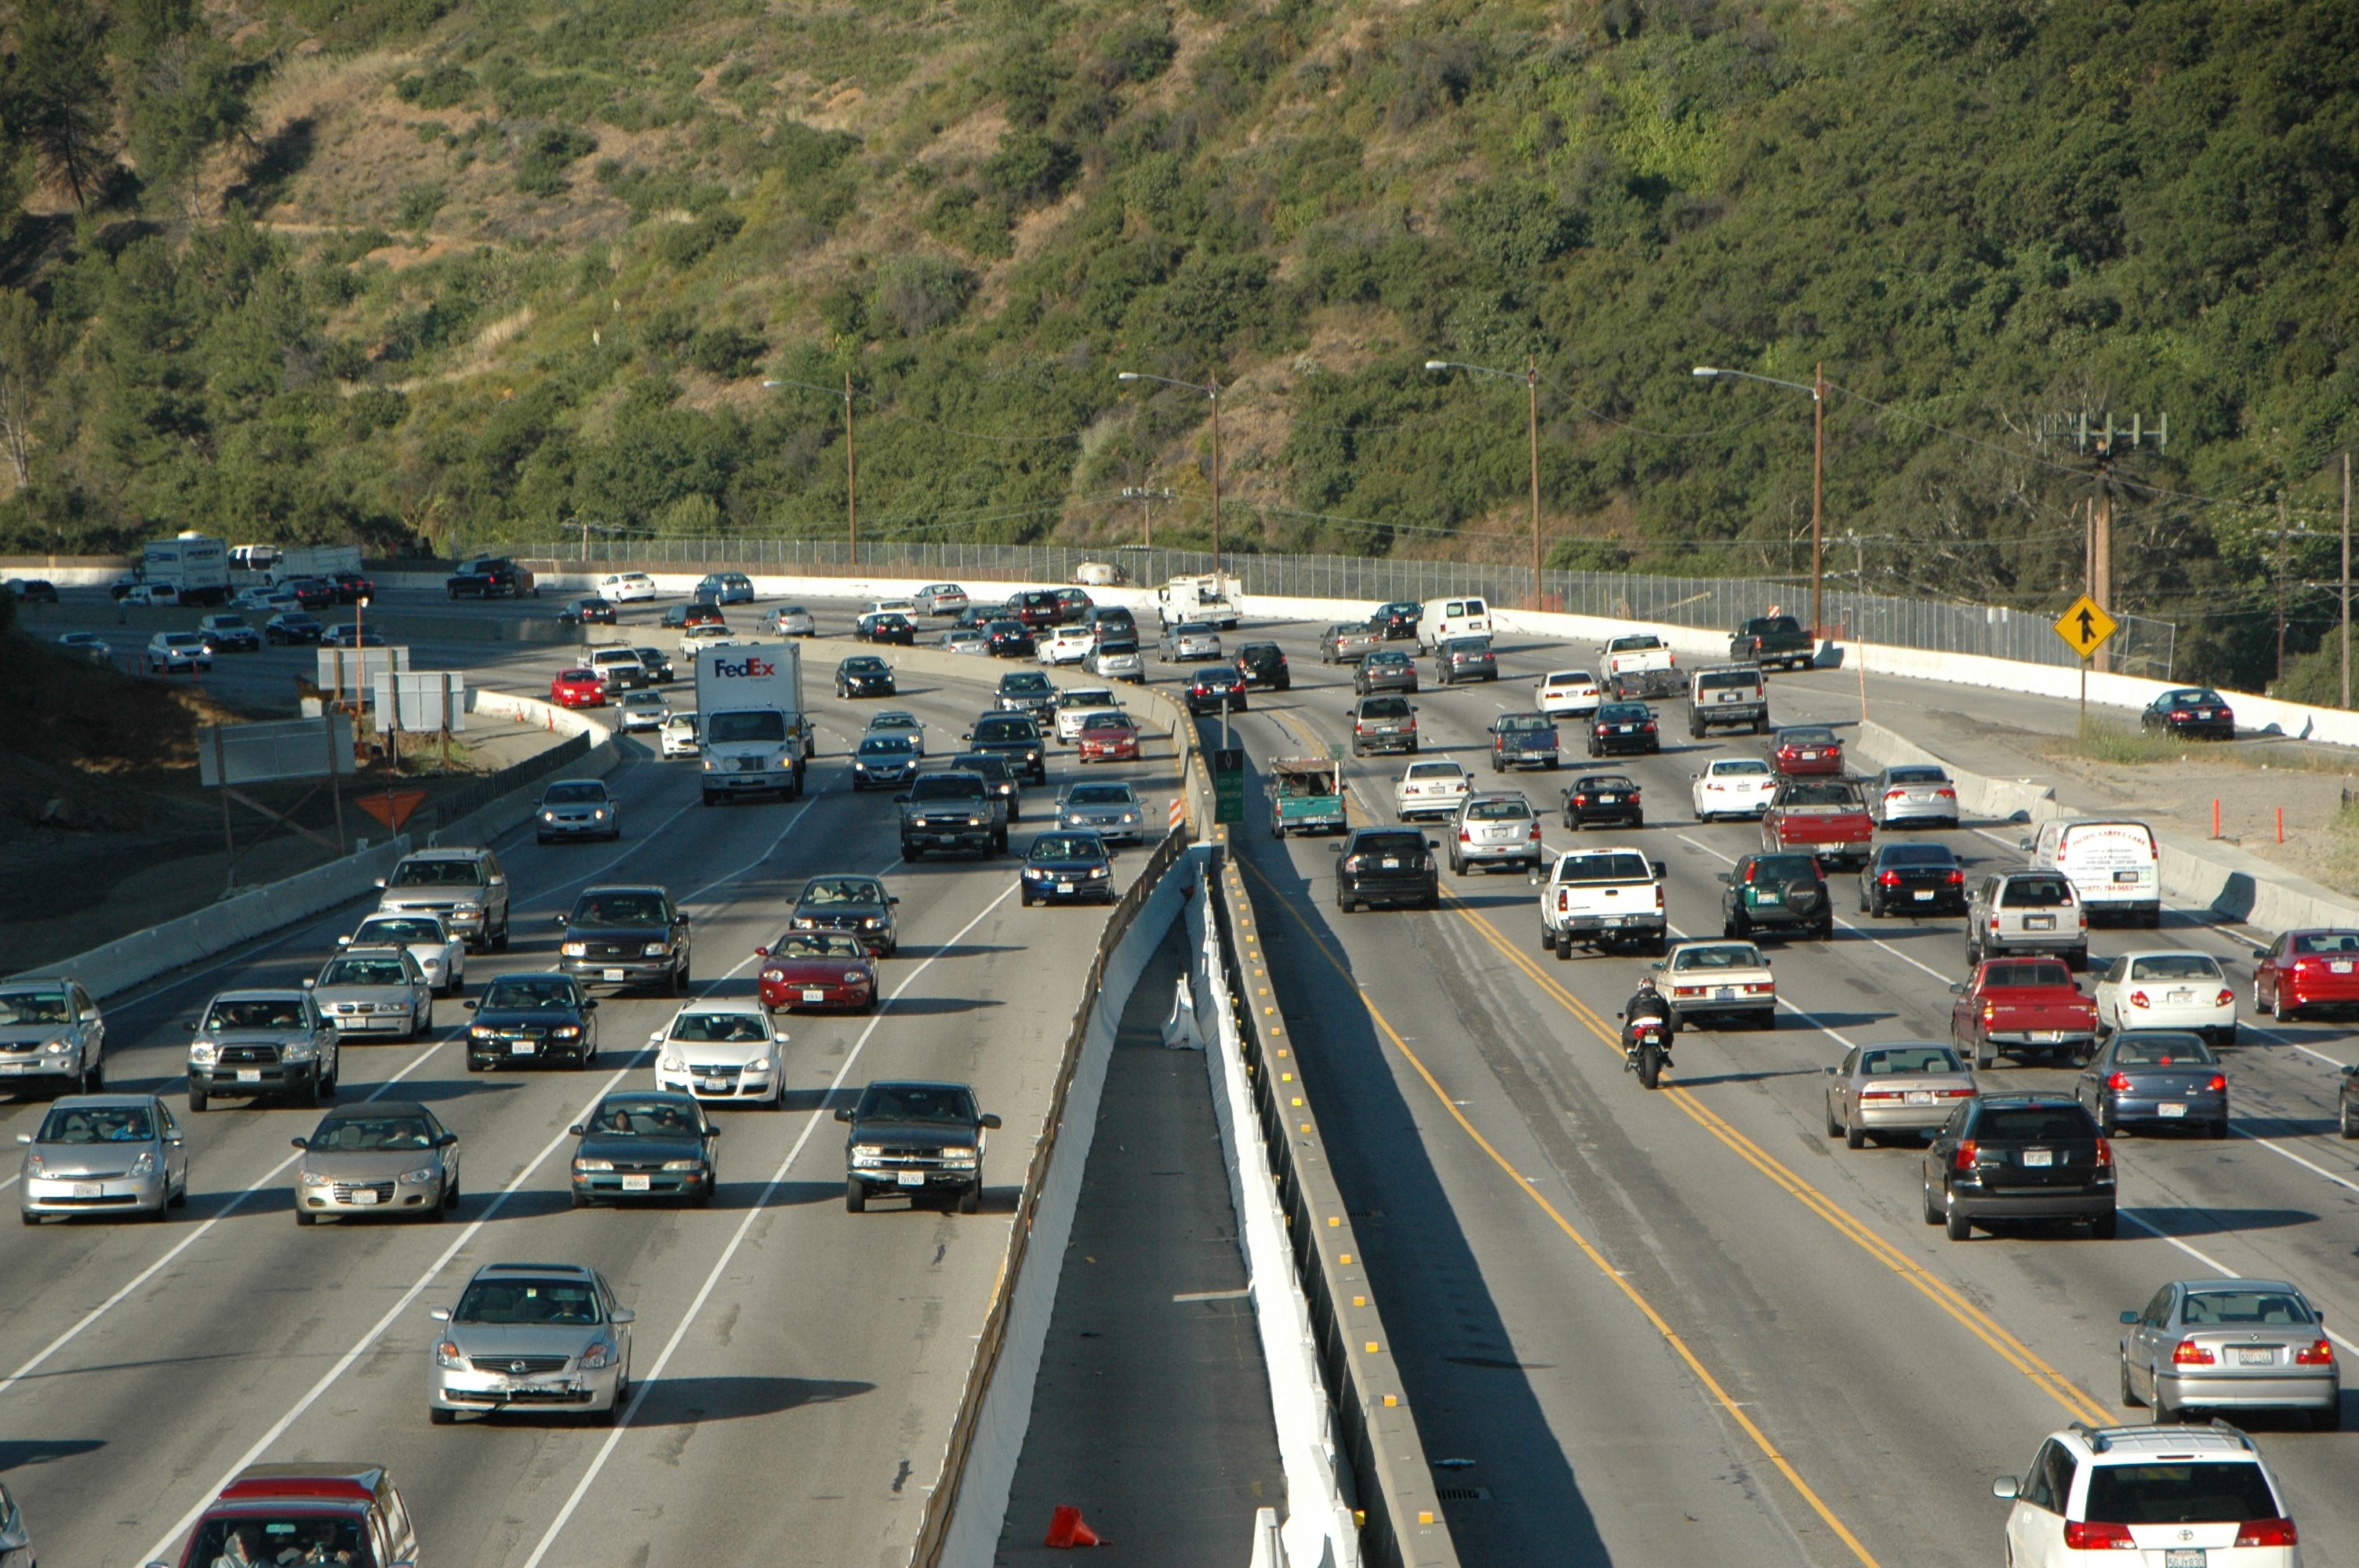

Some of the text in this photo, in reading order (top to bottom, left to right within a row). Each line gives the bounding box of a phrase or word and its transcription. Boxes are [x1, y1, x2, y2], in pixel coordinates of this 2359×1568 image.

[714, 658, 776, 678] FedEx
[2073, 833, 2095, 845] PACIFIC
[2128, 834, 2146, 845] CARE
